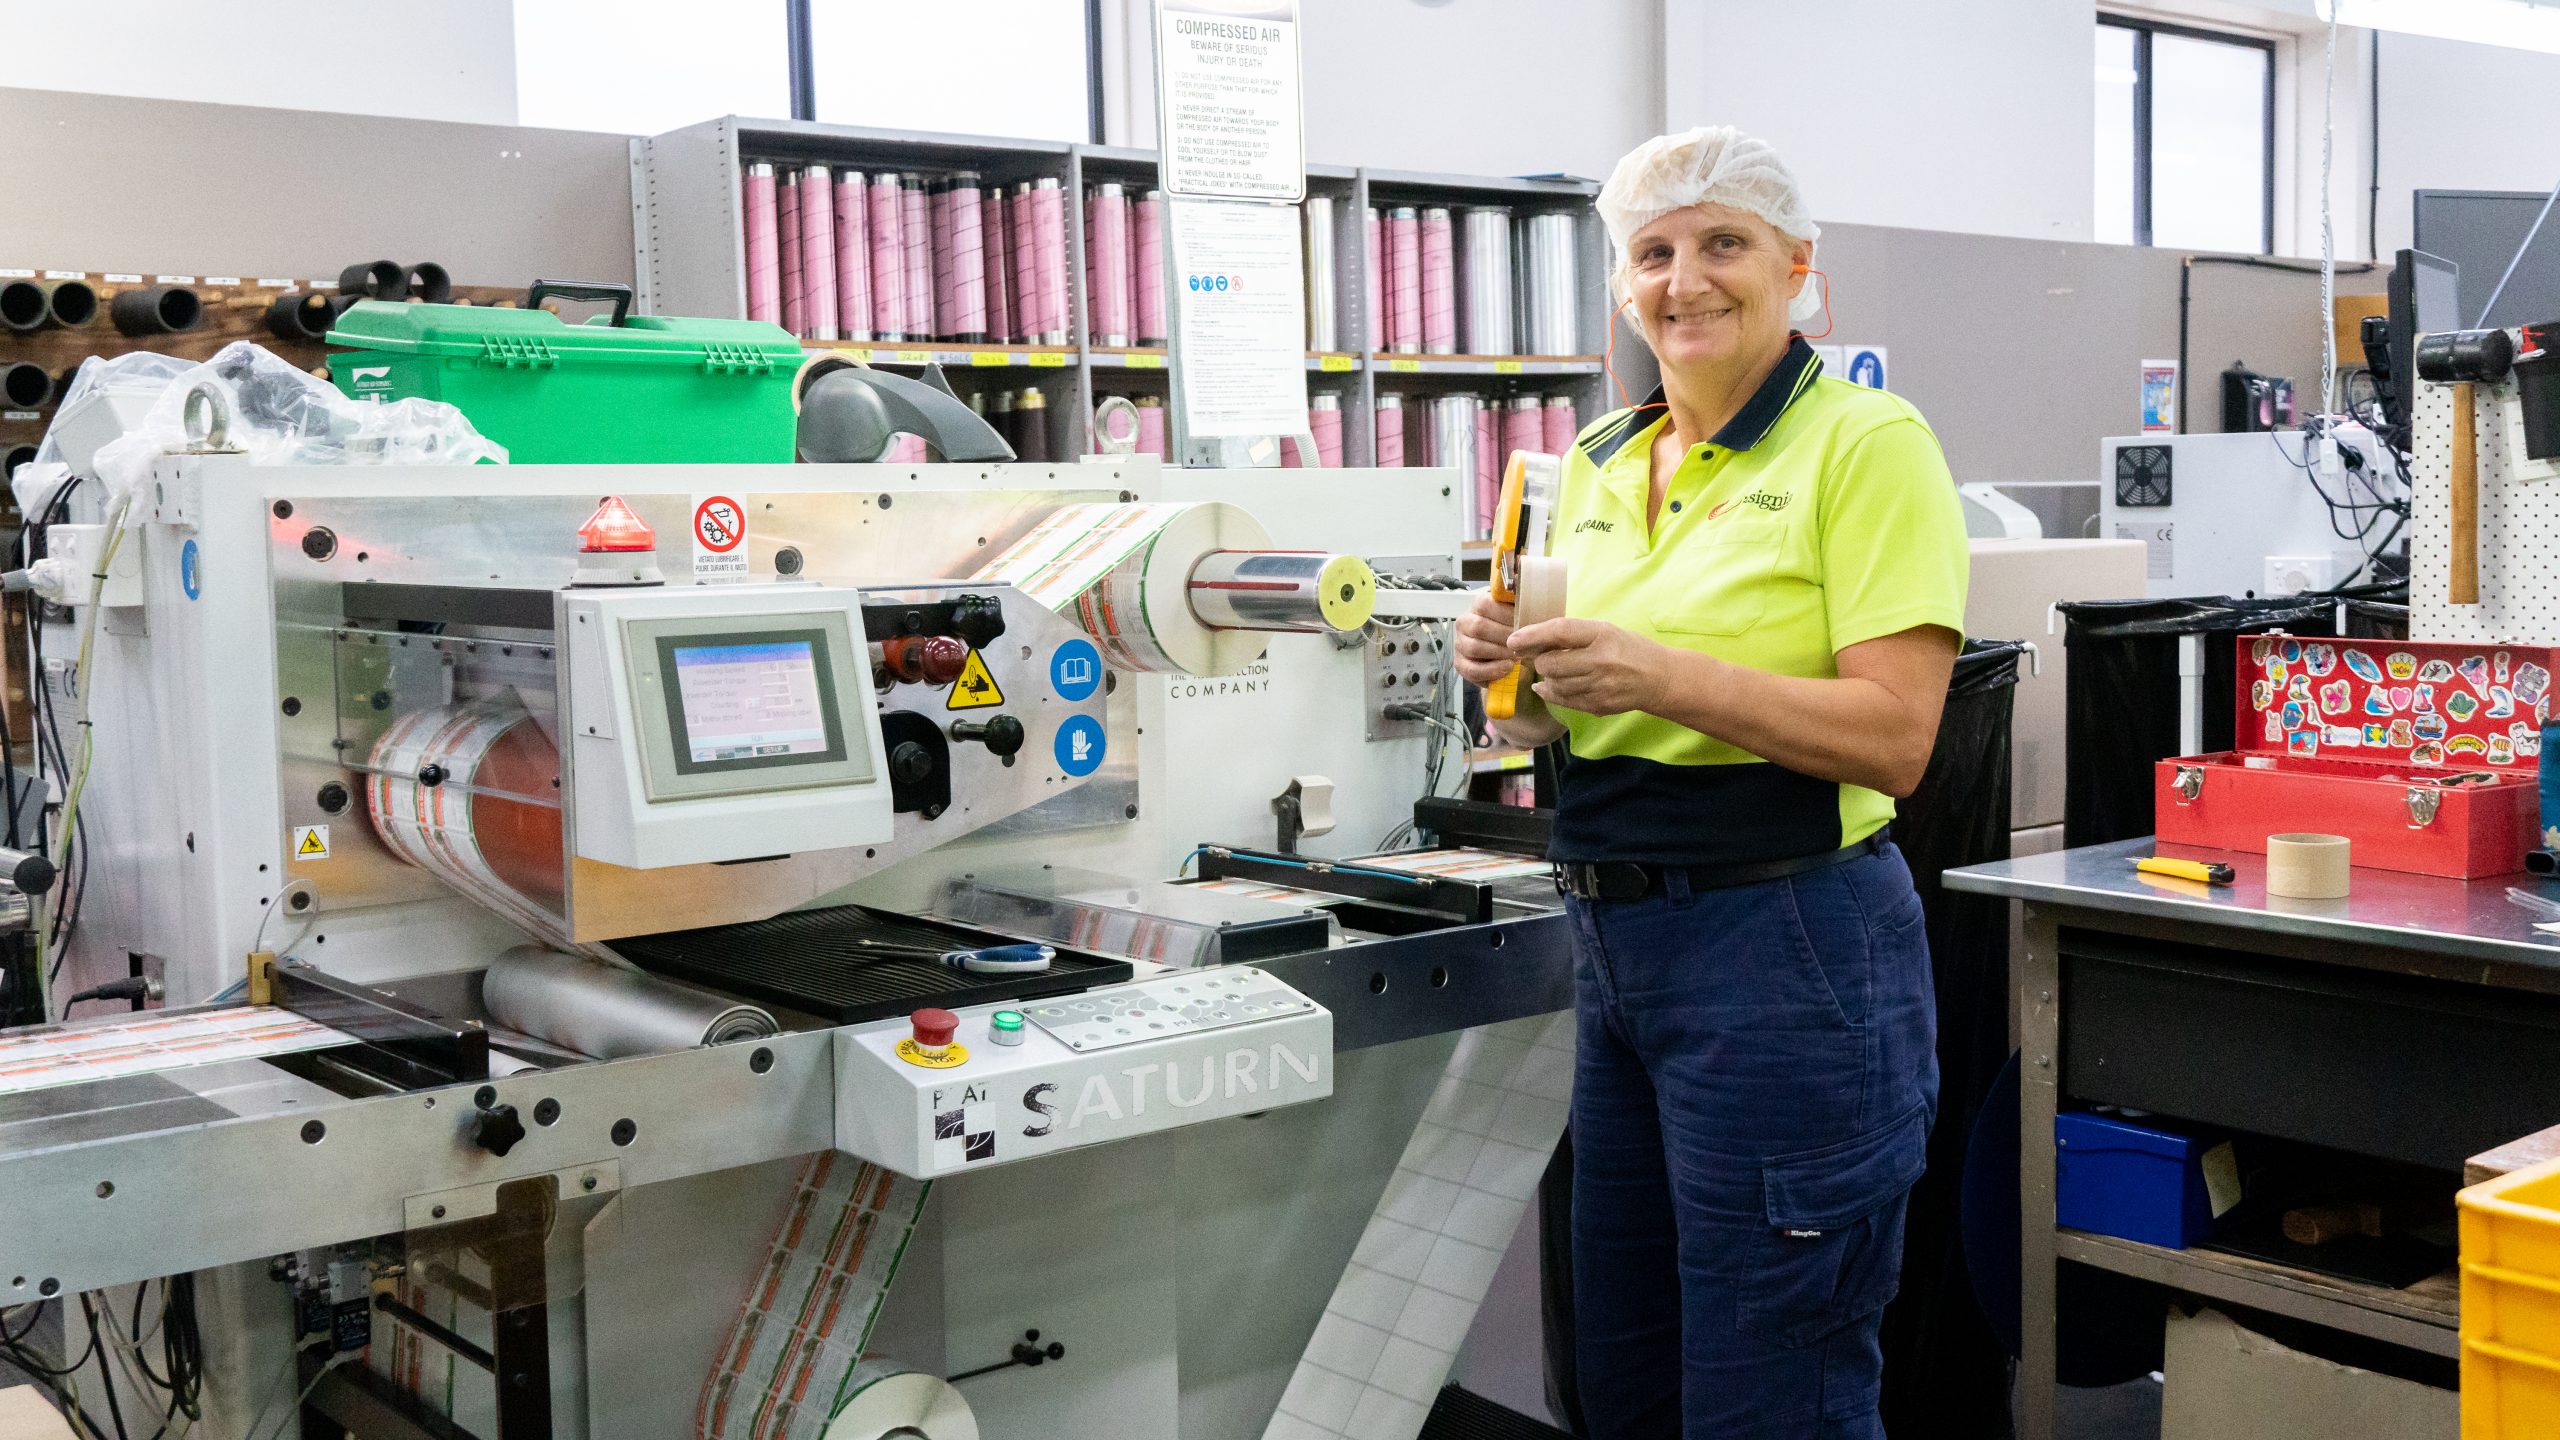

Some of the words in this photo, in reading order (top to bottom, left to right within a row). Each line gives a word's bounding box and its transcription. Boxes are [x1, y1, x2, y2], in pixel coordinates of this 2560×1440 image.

[1176, 19, 1257, 40] COMPRESSED
[1261, 27, 1280, 43] AIR
[1190, 40, 1222, 52] BEWARE
[1224, 43, 1233, 52] OF
[1236, 44, 1268, 56] SERIOUS
[1197, 54, 1224, 65] INJURY
[1226, 56, 1237, 66] OR
[1239, 58, 1263, 69] DEATH
[1182, 104, 1200, 112] NEVER
[1176, 114, 1212, 122] COMPRESSED
[1216, 139, 1252, 148] COMPRESSED
[1193, 146, 1219, 155] YOURSELF
[1194, 156, 1204, 164] THE
[1244, 182, 1280, 191] COMPRESSED
[710, 564, 729, 572] DURANTE
[1171, 680, 1268, 698] COMPANY
[924, 1056, 957, 1064] STOP
[1022, 1042, 1319, 1138] SATURN
[1790, 1230, 1821, 1238] KingGee
